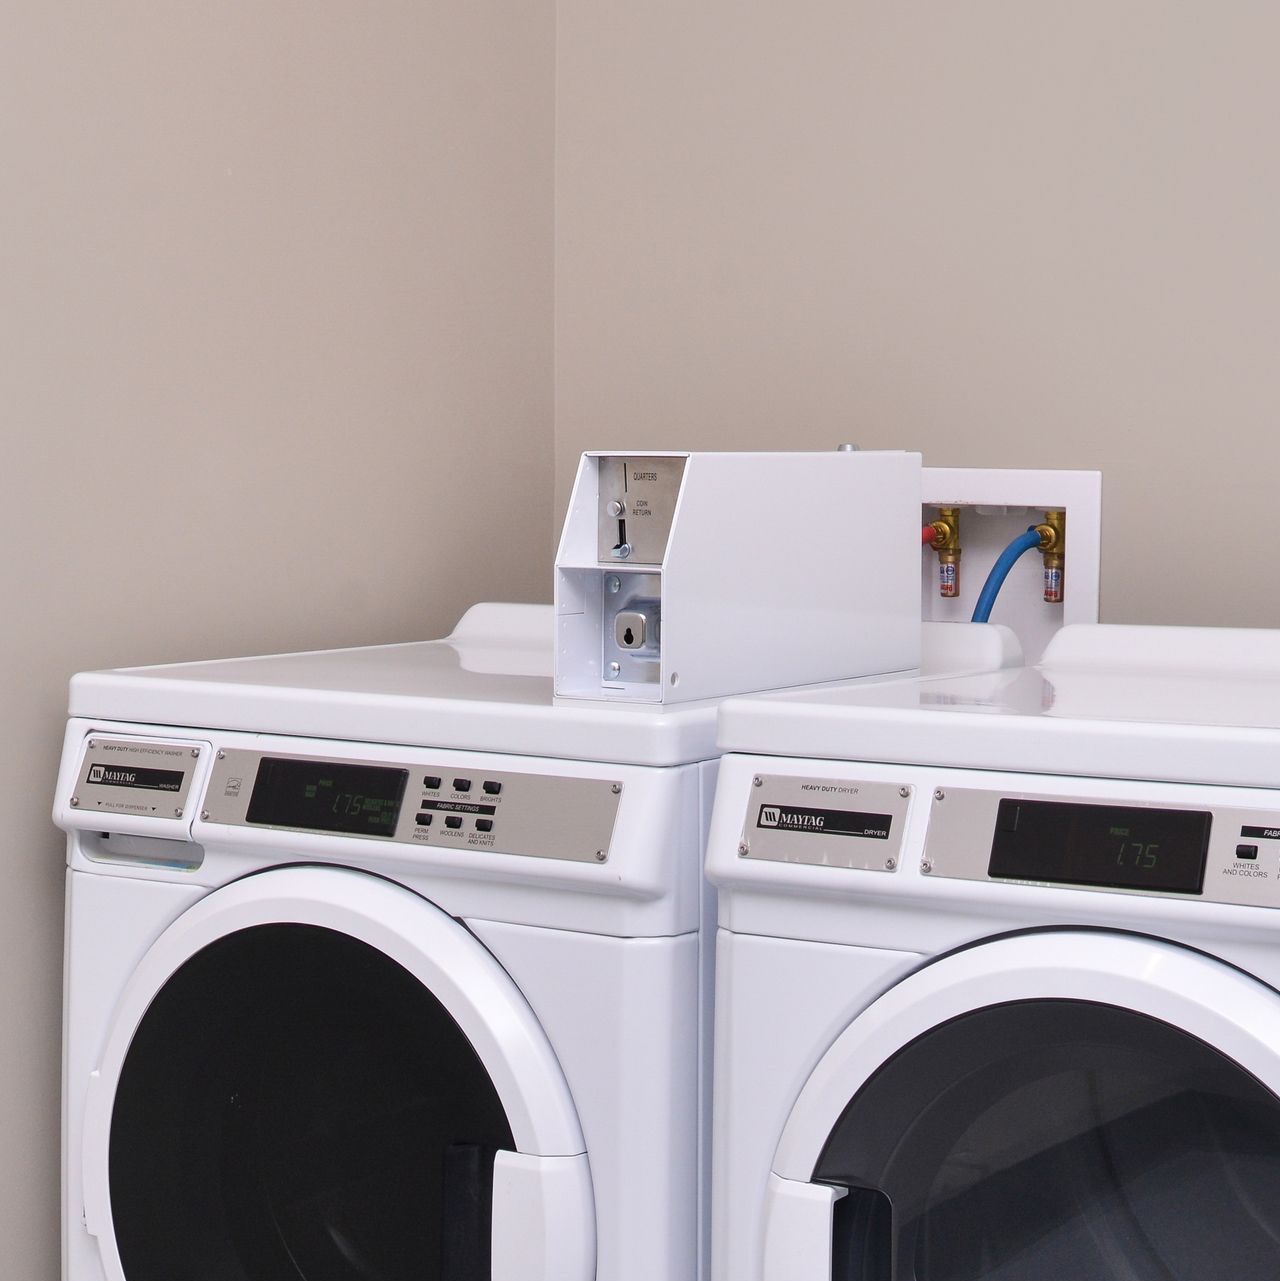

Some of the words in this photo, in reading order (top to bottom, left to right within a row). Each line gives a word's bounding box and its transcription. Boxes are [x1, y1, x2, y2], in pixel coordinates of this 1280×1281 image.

[633, 472, 657, 481] QUARTERS
[103, 771, 136, 782] MAYTAG
[437, 802, 454, 810] FABRIC
[455, 804, 480, 812] SETTINGS
[780, 813, 825, 827] MAYTAG
[440, 830, 464, 838] WOOLENS
[778, 823, 823, 831] COMMERCIAL
[863, 829, 887, 837] DRYER
[1117, 843, 1160, 868] 1.75
[1232, 862, 1260, 870] WHITES
[1222, 868, 1238, 876] AND
[1239, 869, 1269, 878] COLORS
